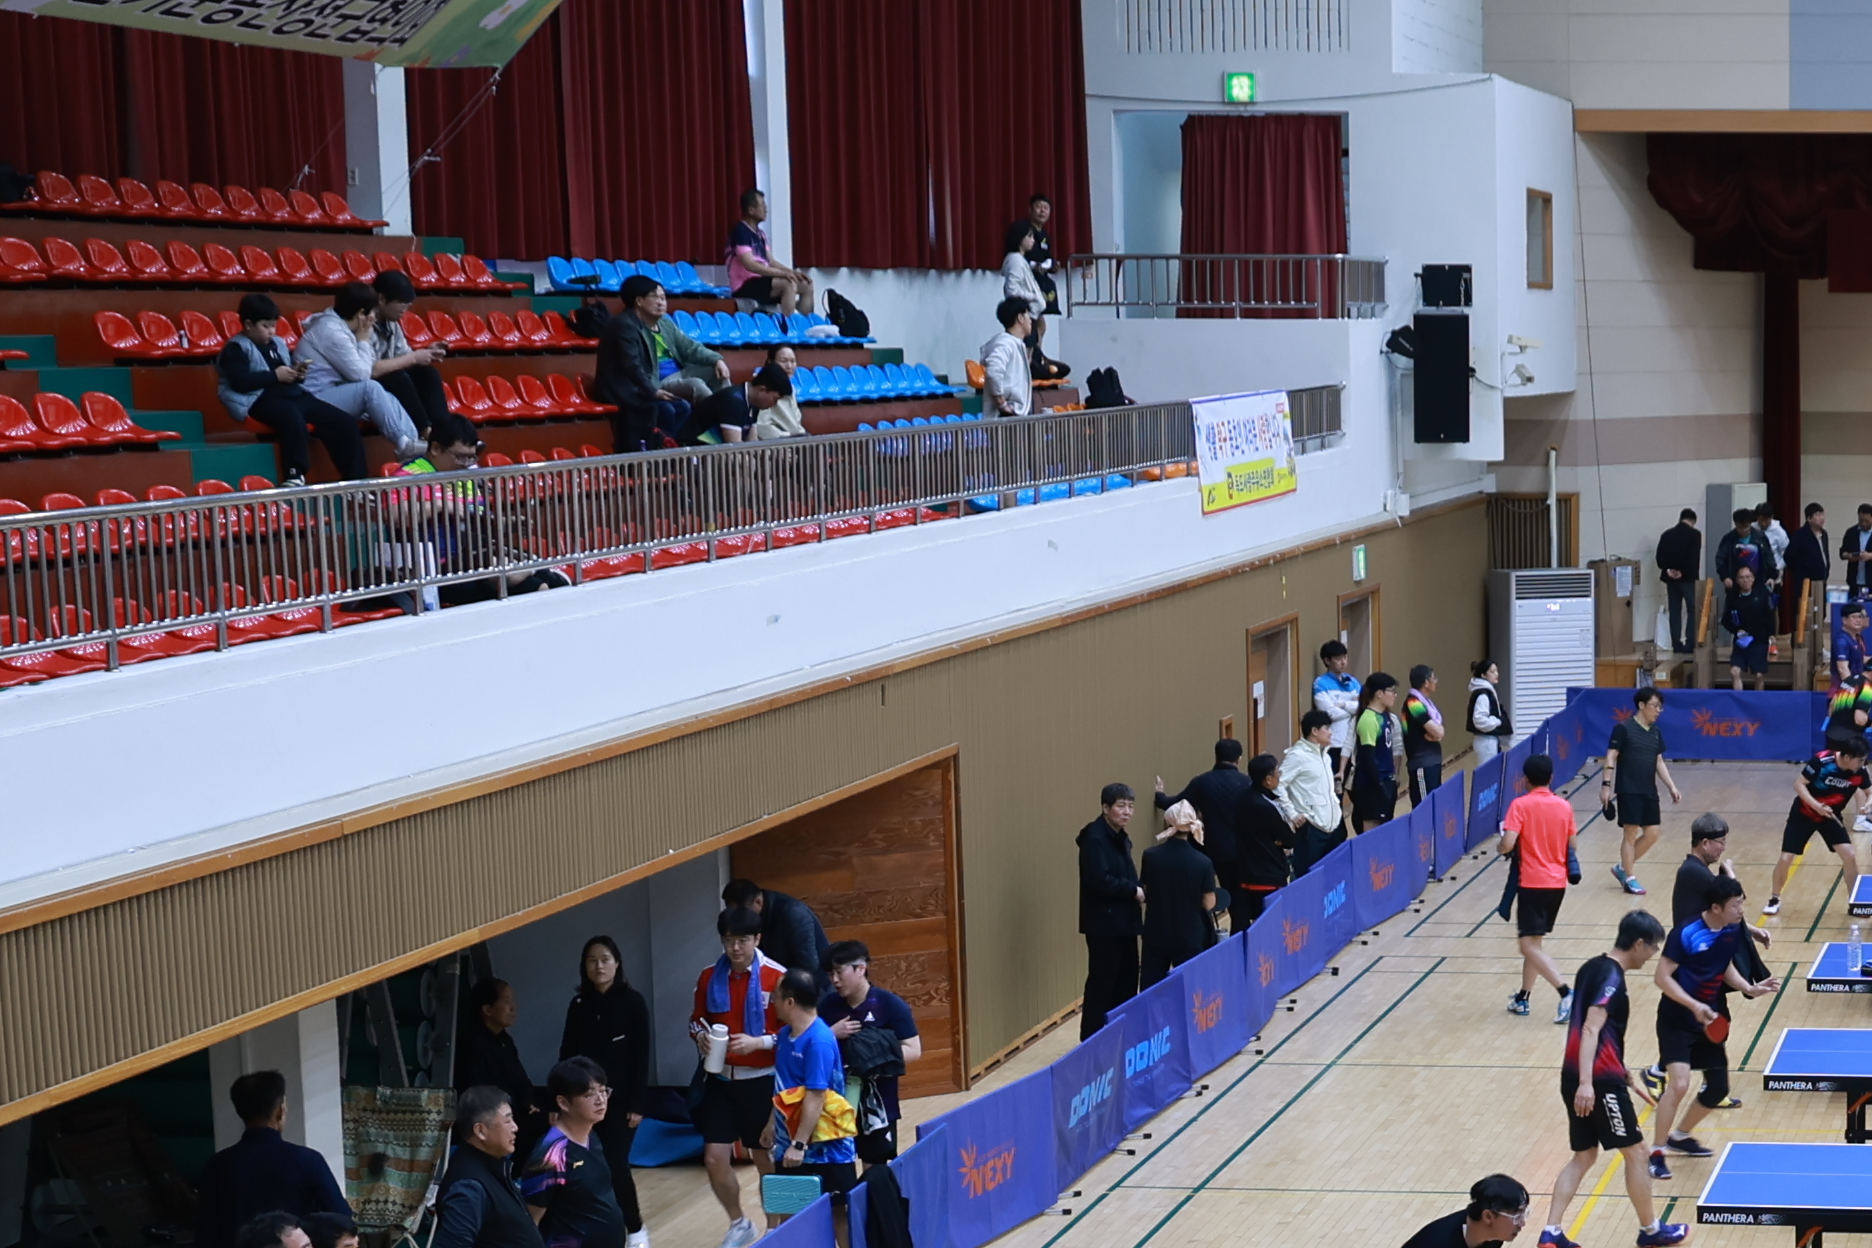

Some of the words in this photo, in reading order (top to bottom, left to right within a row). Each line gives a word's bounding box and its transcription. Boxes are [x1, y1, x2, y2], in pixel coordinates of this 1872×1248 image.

[1703, 721, 1760, 737] NEXY
[1810, 983, 1850, 992] PANTHERA
[1125, 1025, 1172, 1079] DONIC
[1067, 1066, 1115, 1129] DONIC
[1768, 1080, 1813, 1090] PANTHERA
[1604, 1092, 1628, 1137] UPTON
[969, 1146, 1017, 1199] NEXY
[1702, 1212, 1755, 1224] PANTHERA
